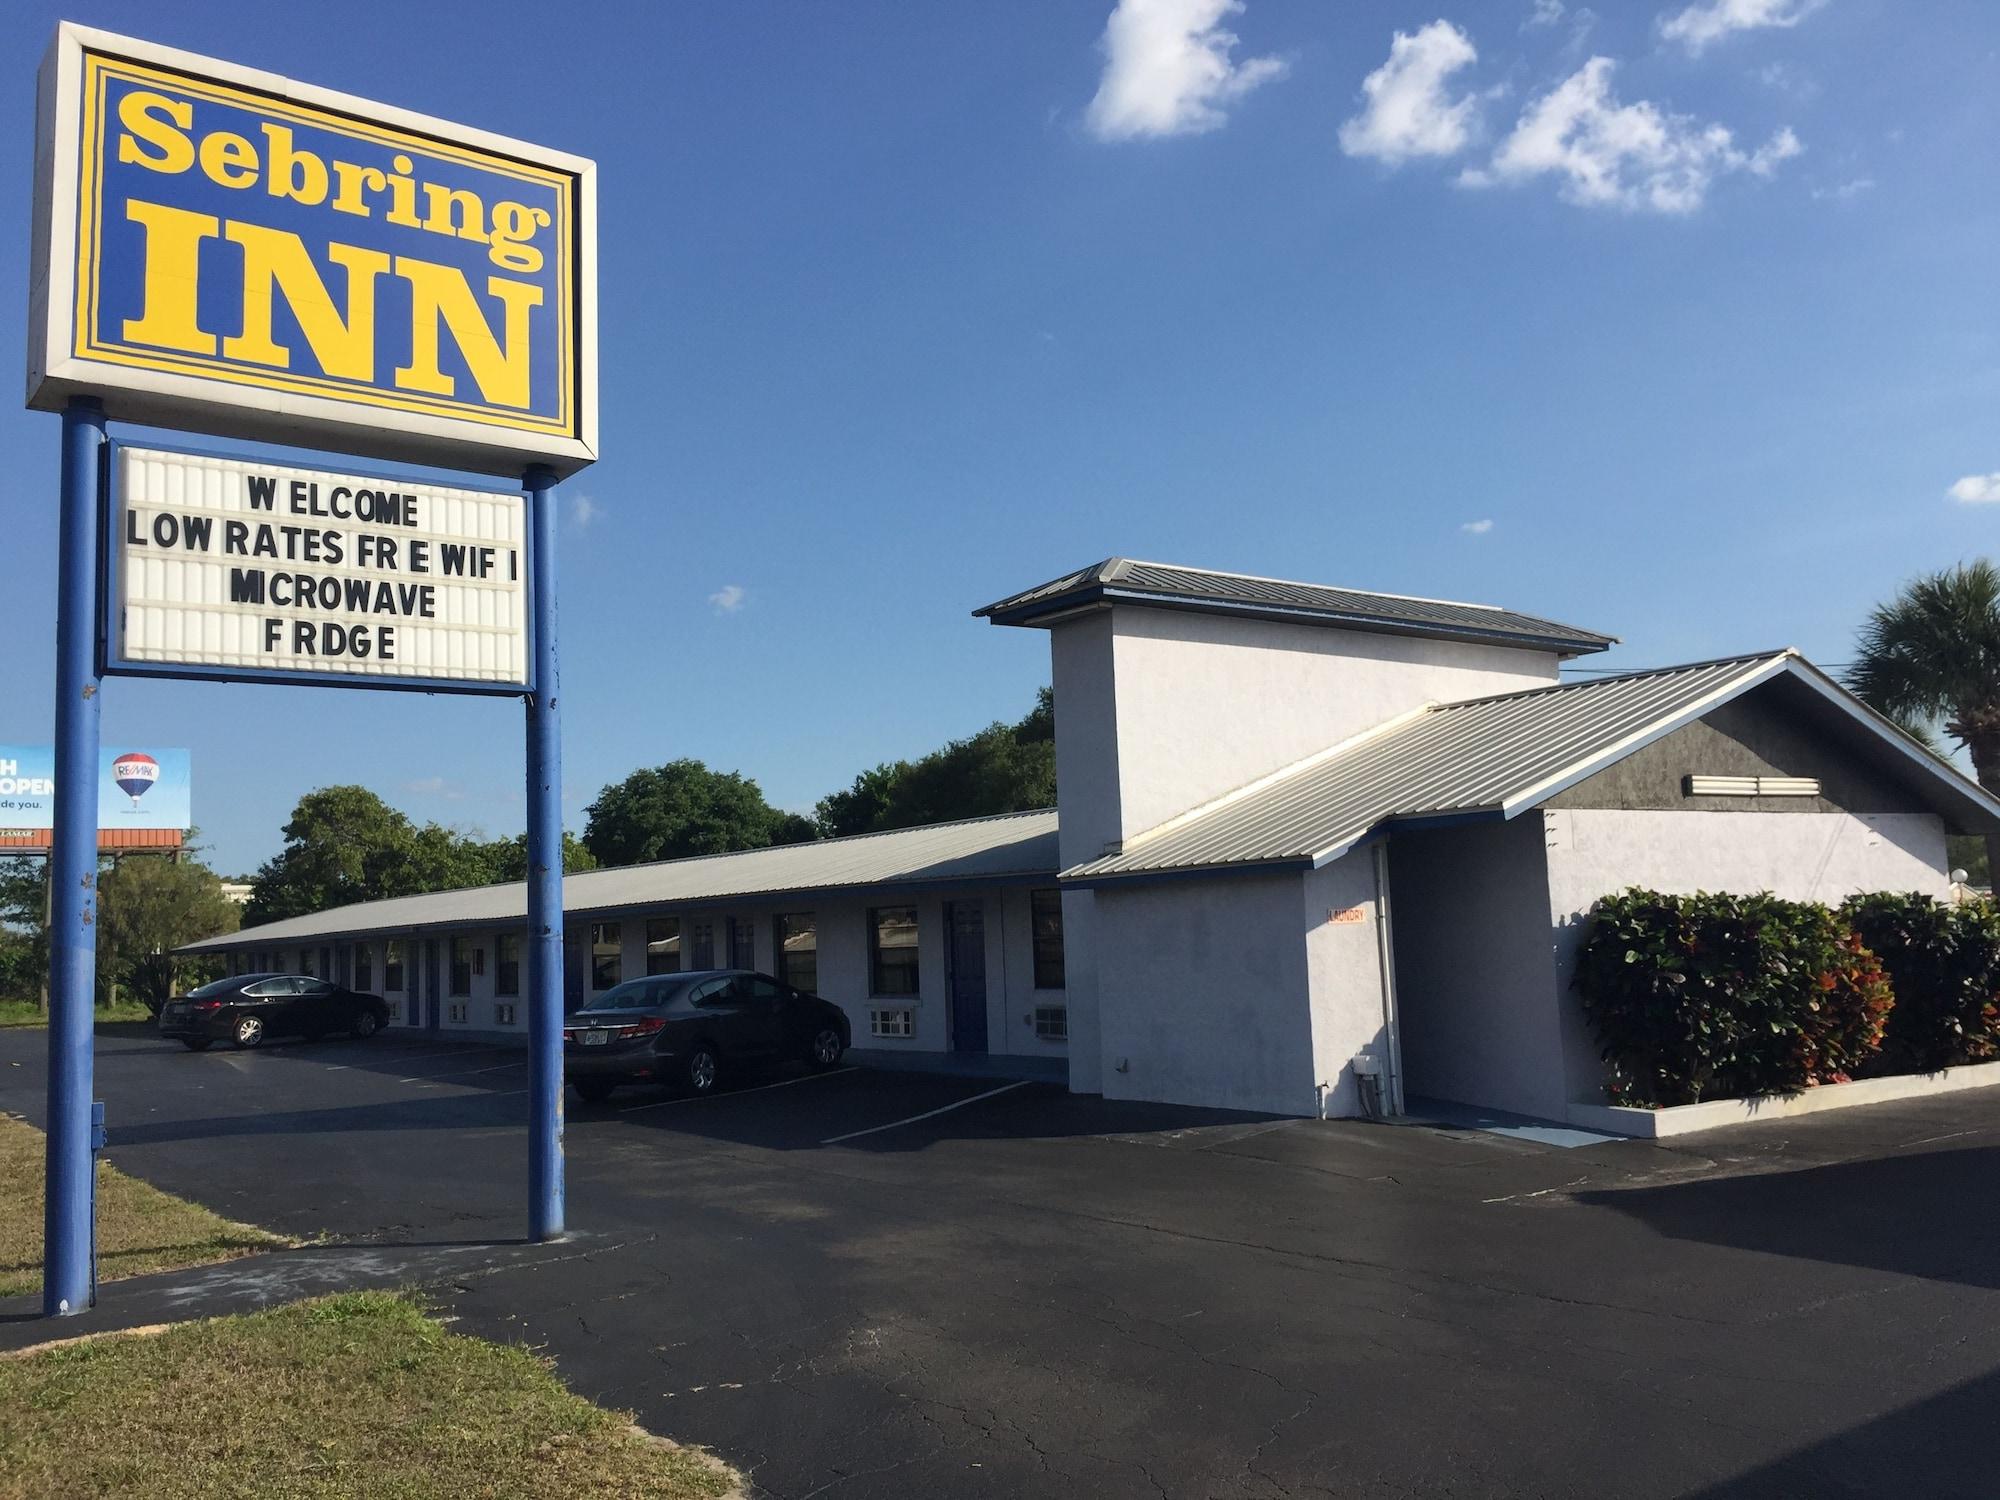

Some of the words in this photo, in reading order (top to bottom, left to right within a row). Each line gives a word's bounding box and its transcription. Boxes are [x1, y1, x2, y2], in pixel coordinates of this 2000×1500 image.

[118, 91, 551, 273] Sebring
[122, 198, 544, 410] INN
[247, 475, 418, 528] WELCOME
[127, 509, 213, 551] LOW
[225, 521, 344, 564] RATES
[230, 567, 436, 618] MICROWAVE
[18, 801, 43, 811] you.
[1329, 909, 1363, 921] LAUNDRY
